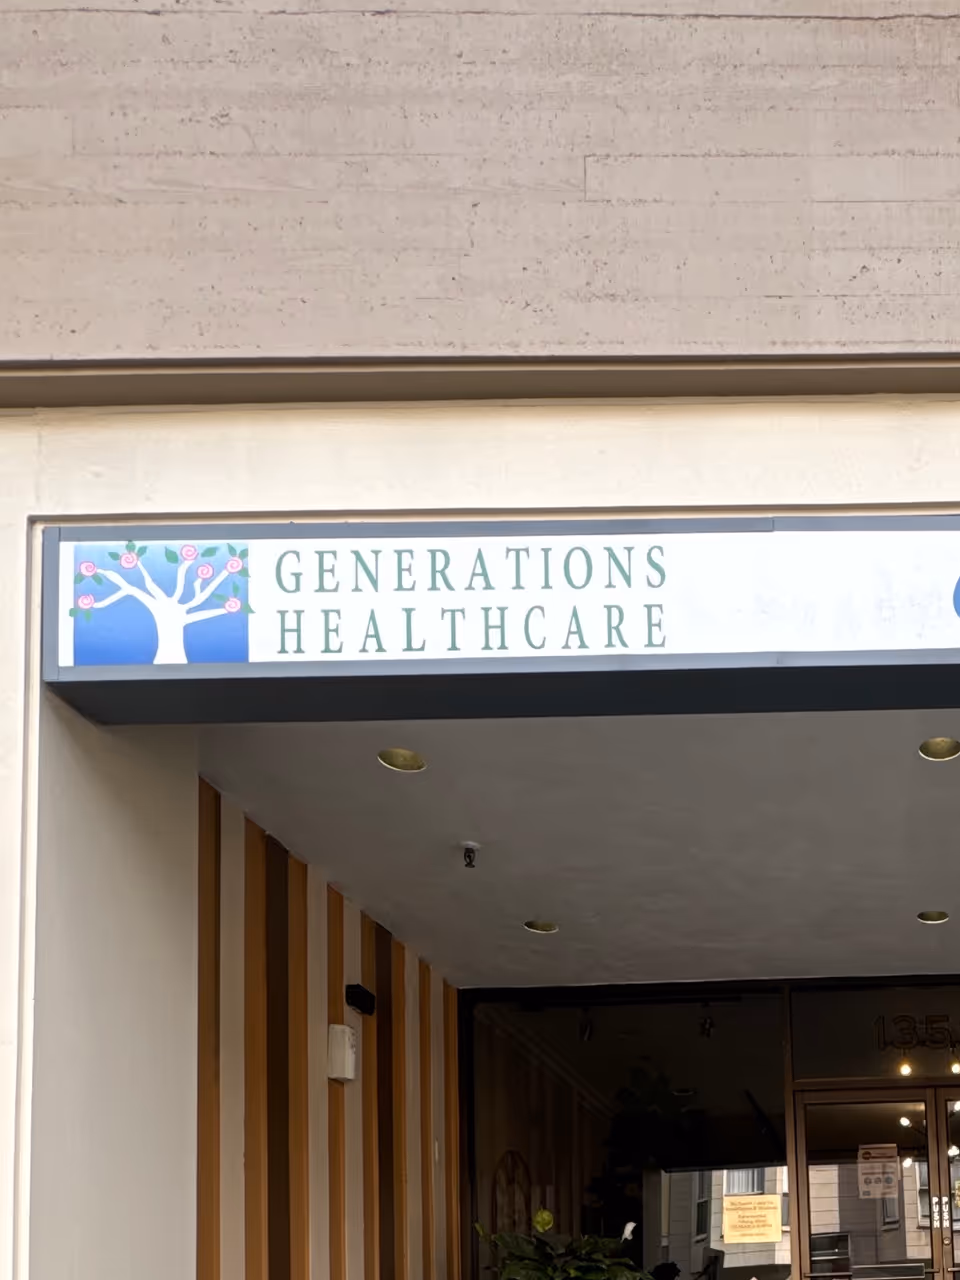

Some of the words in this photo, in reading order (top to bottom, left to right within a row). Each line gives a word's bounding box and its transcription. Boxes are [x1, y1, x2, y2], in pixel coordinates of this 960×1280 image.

[275, 545, 668, 594] GENERATIONS
[276, 604, 668, 655] HEALTHCARE
[932, 1197, 940, 1229] PUSH
[942, 1197, 950, 1228] PUSH
